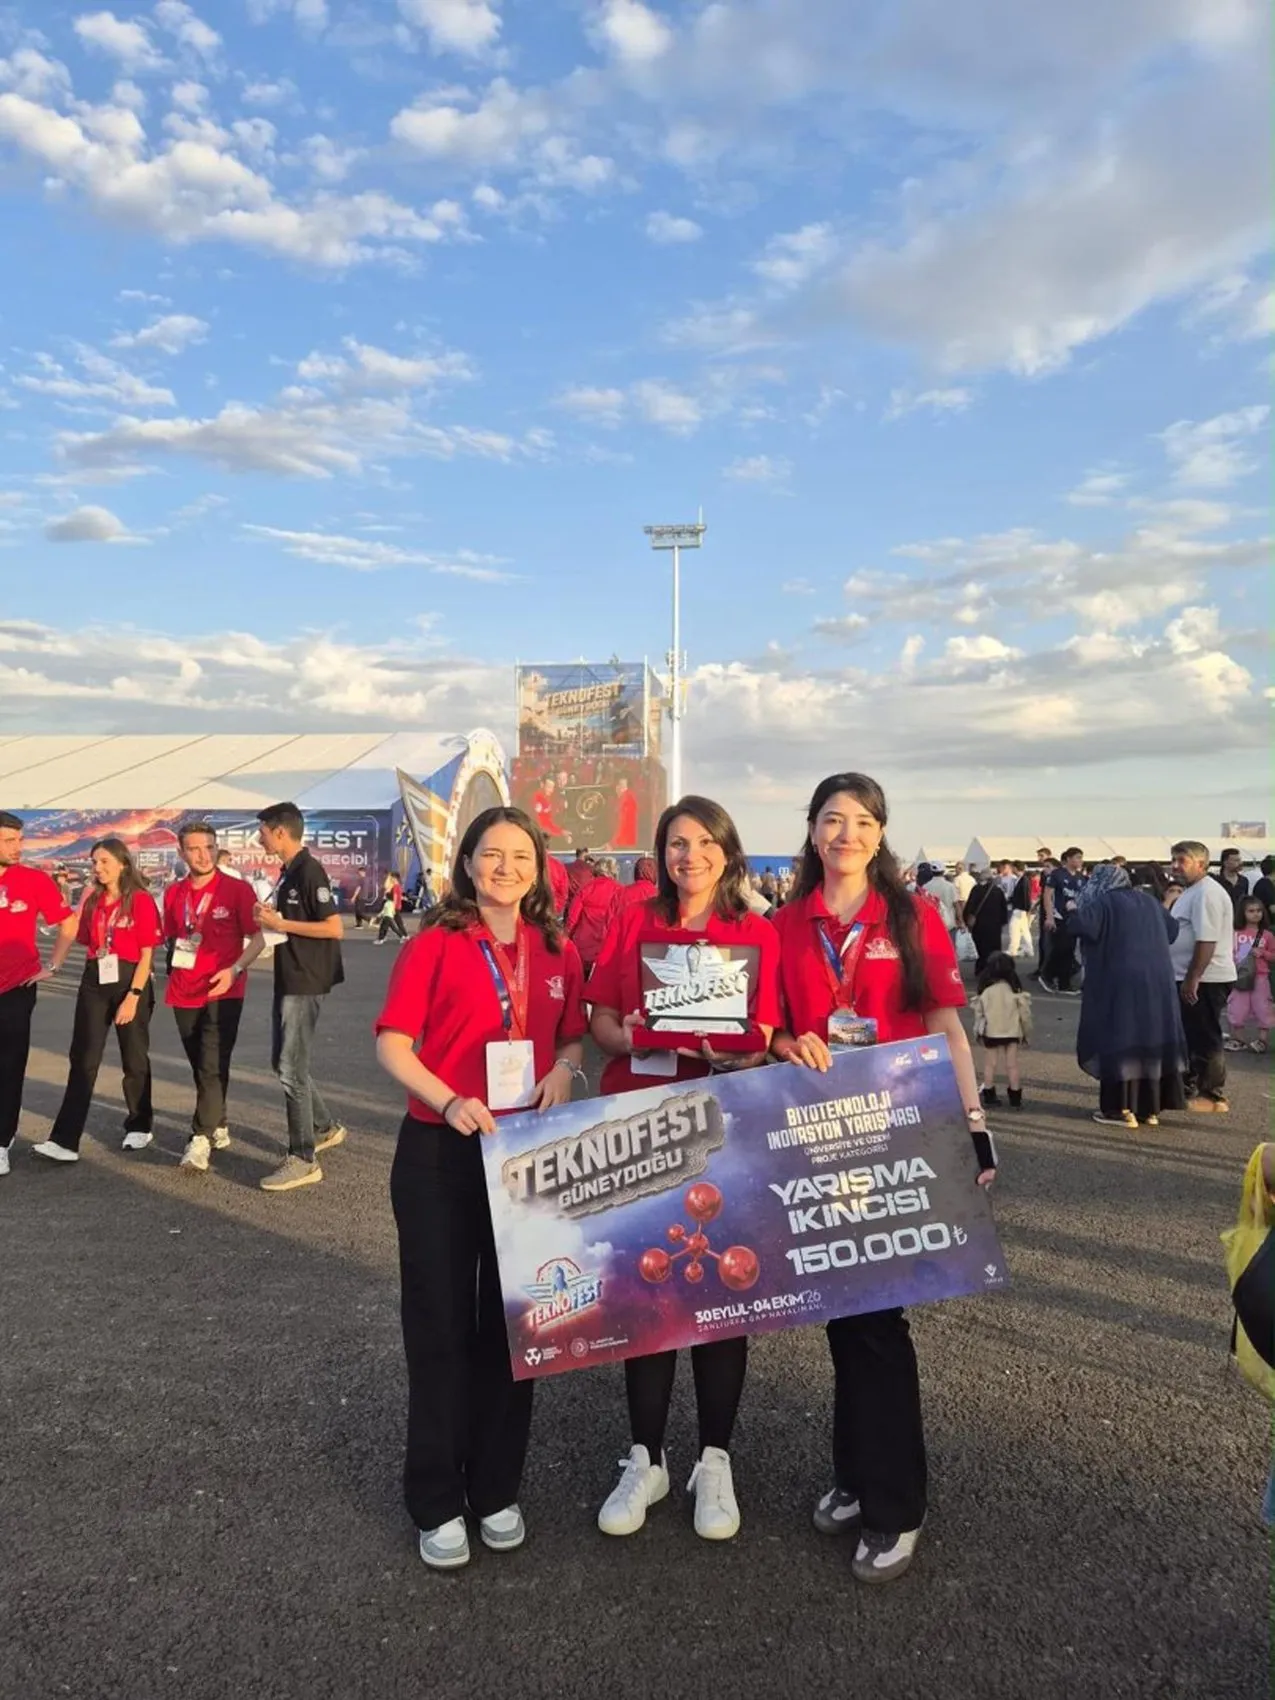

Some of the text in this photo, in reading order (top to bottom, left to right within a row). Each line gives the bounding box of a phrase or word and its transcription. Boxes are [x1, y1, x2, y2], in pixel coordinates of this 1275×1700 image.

[545, 684, 621, 707] TEKNOFEST
[214, 829, 368, 849] TEKFEST
[844, 1105, 921, 1136] YARIŞMASI
[509, 1097, 712, 1200] TEKNOFEST
[558, 1147, 684, 1208] GÜNEYDOĞU
[768, 1157, 937, 1206] YARIŞMA
[526, 1280, 602, 1330] TEKNOFEST
